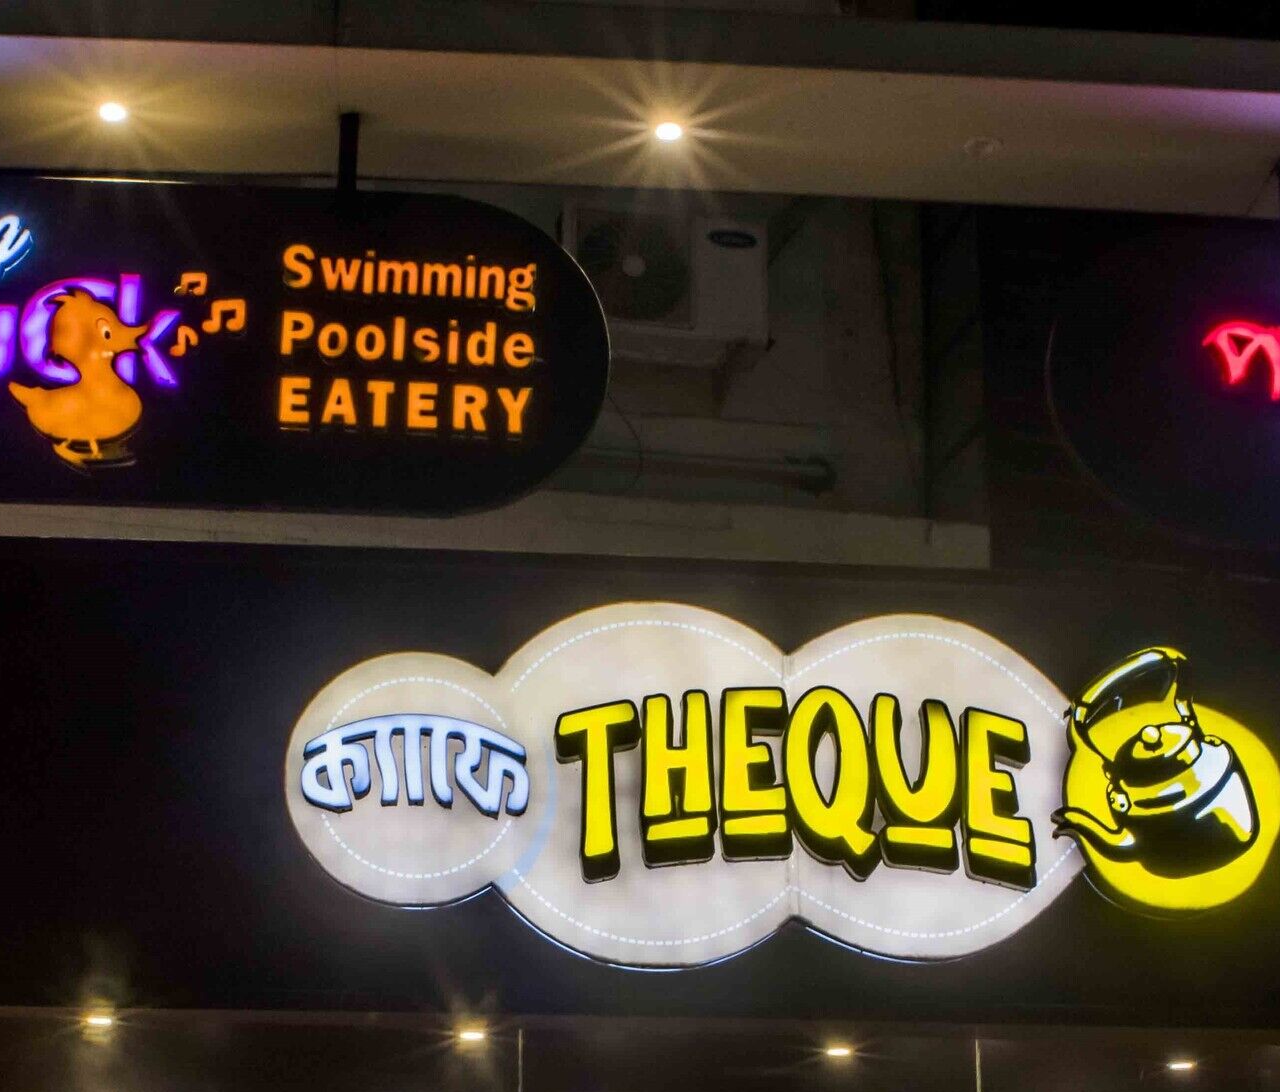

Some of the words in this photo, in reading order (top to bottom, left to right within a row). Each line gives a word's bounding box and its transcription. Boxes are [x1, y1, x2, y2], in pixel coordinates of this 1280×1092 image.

[281, 240, 538, 311] Swimming
[279, 310, 536, 369] Poolside
[278, 375, 534, 435] EATERY
[555, 684, 1038, 888] THEQUE
